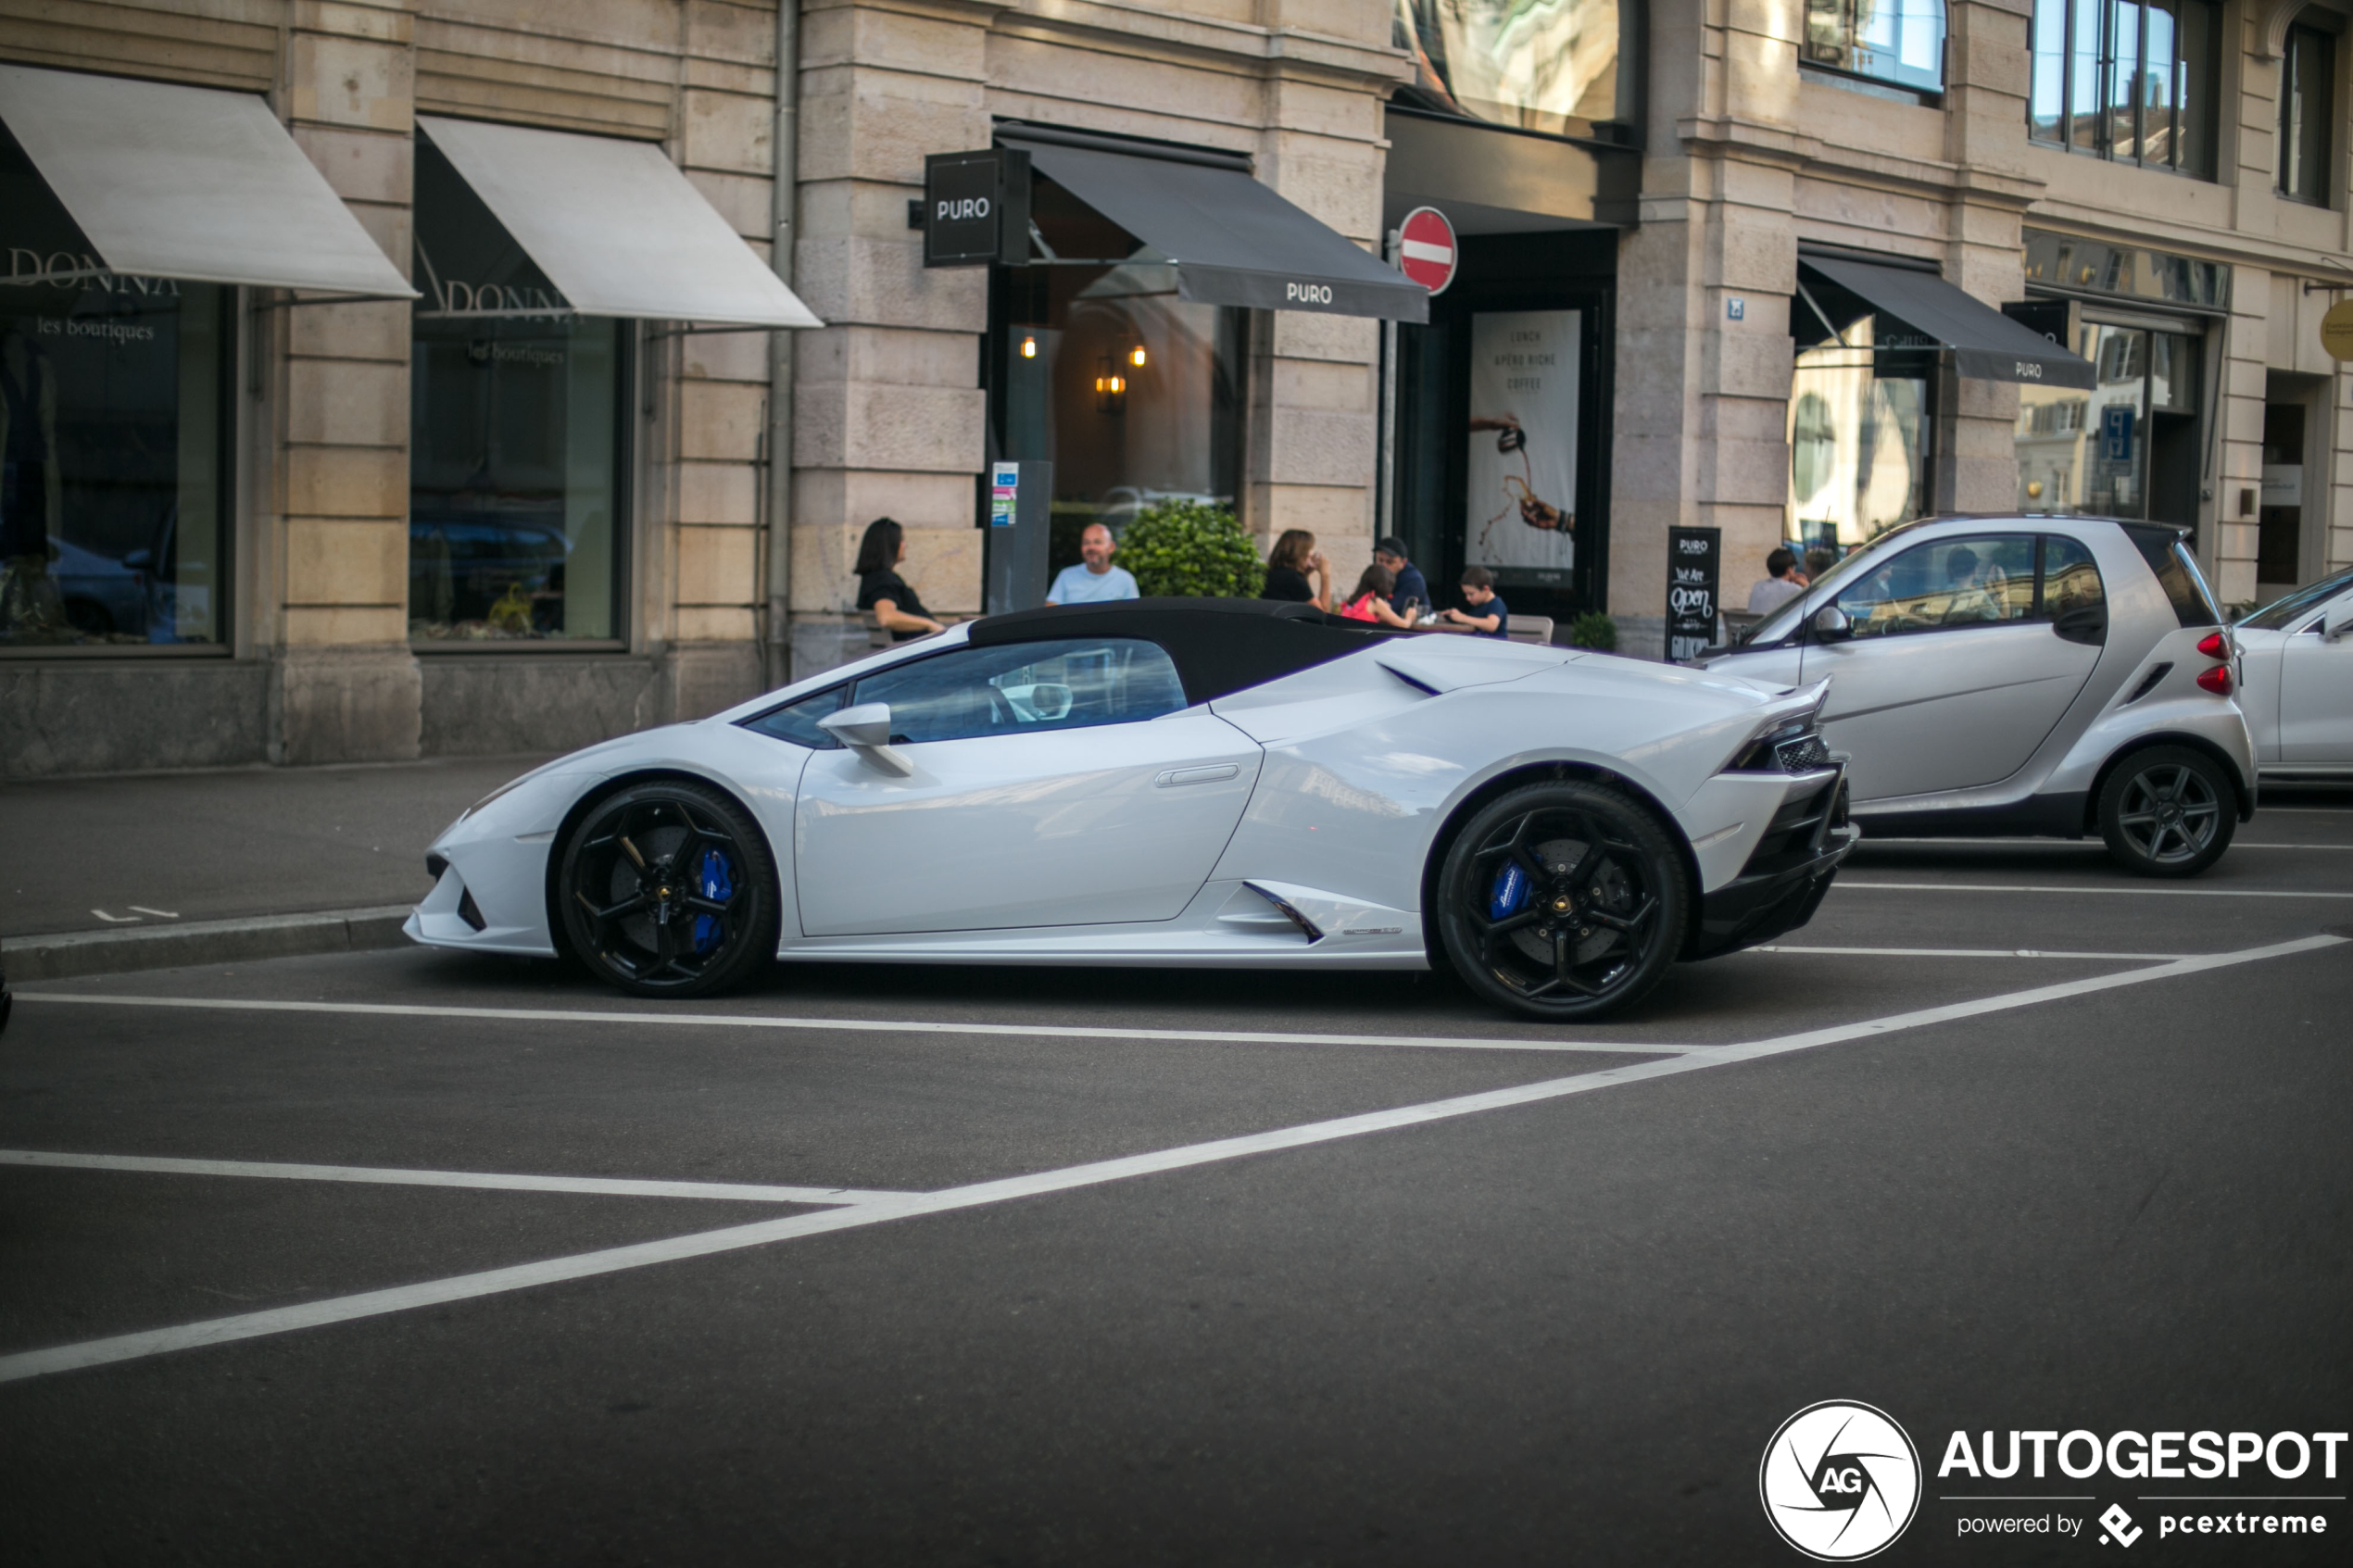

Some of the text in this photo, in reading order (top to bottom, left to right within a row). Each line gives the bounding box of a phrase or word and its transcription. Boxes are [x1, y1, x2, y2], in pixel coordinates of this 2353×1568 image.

[937, 197, 990, 220] PURO
[1287, 282, 1333, 305] PURO
[37, 316, 155, 346] les boutiques
[492, 341, 564, 369] boutiques
[2015, 361, 2043, 379] PURO
[1506, 377, 1541, 390] COFFEE
[1680, 538, 1708, 553] PURO
[1670, 586, 1714, 619] Open
